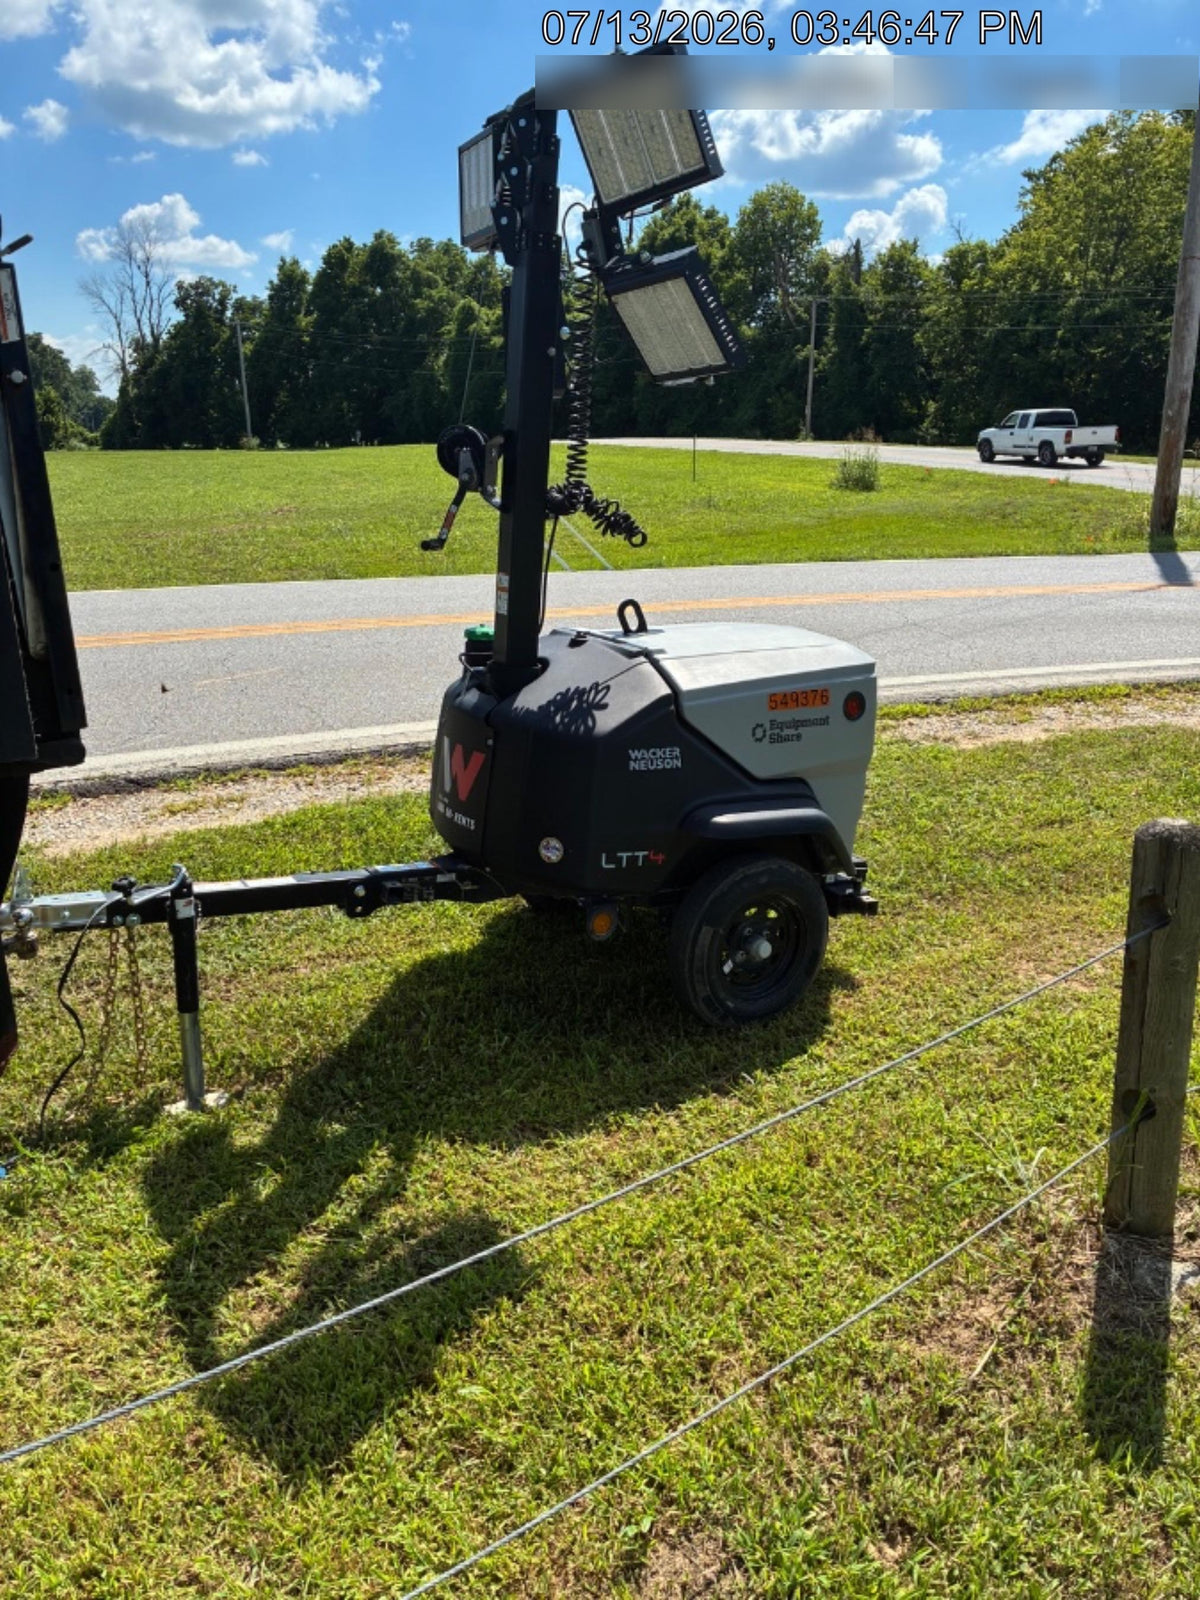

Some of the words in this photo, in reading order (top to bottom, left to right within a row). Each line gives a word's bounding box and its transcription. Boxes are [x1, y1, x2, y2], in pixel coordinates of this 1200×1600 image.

[768, 689, 830, 710] 549376
[768, 716, 830, 732] Equipment
[768, 731, 802, 744] Share
[628, 747, 681, 760] WACKER
[629, 758, 682, 770] NEUSON
[601, 850, 665, 868] LTT4
